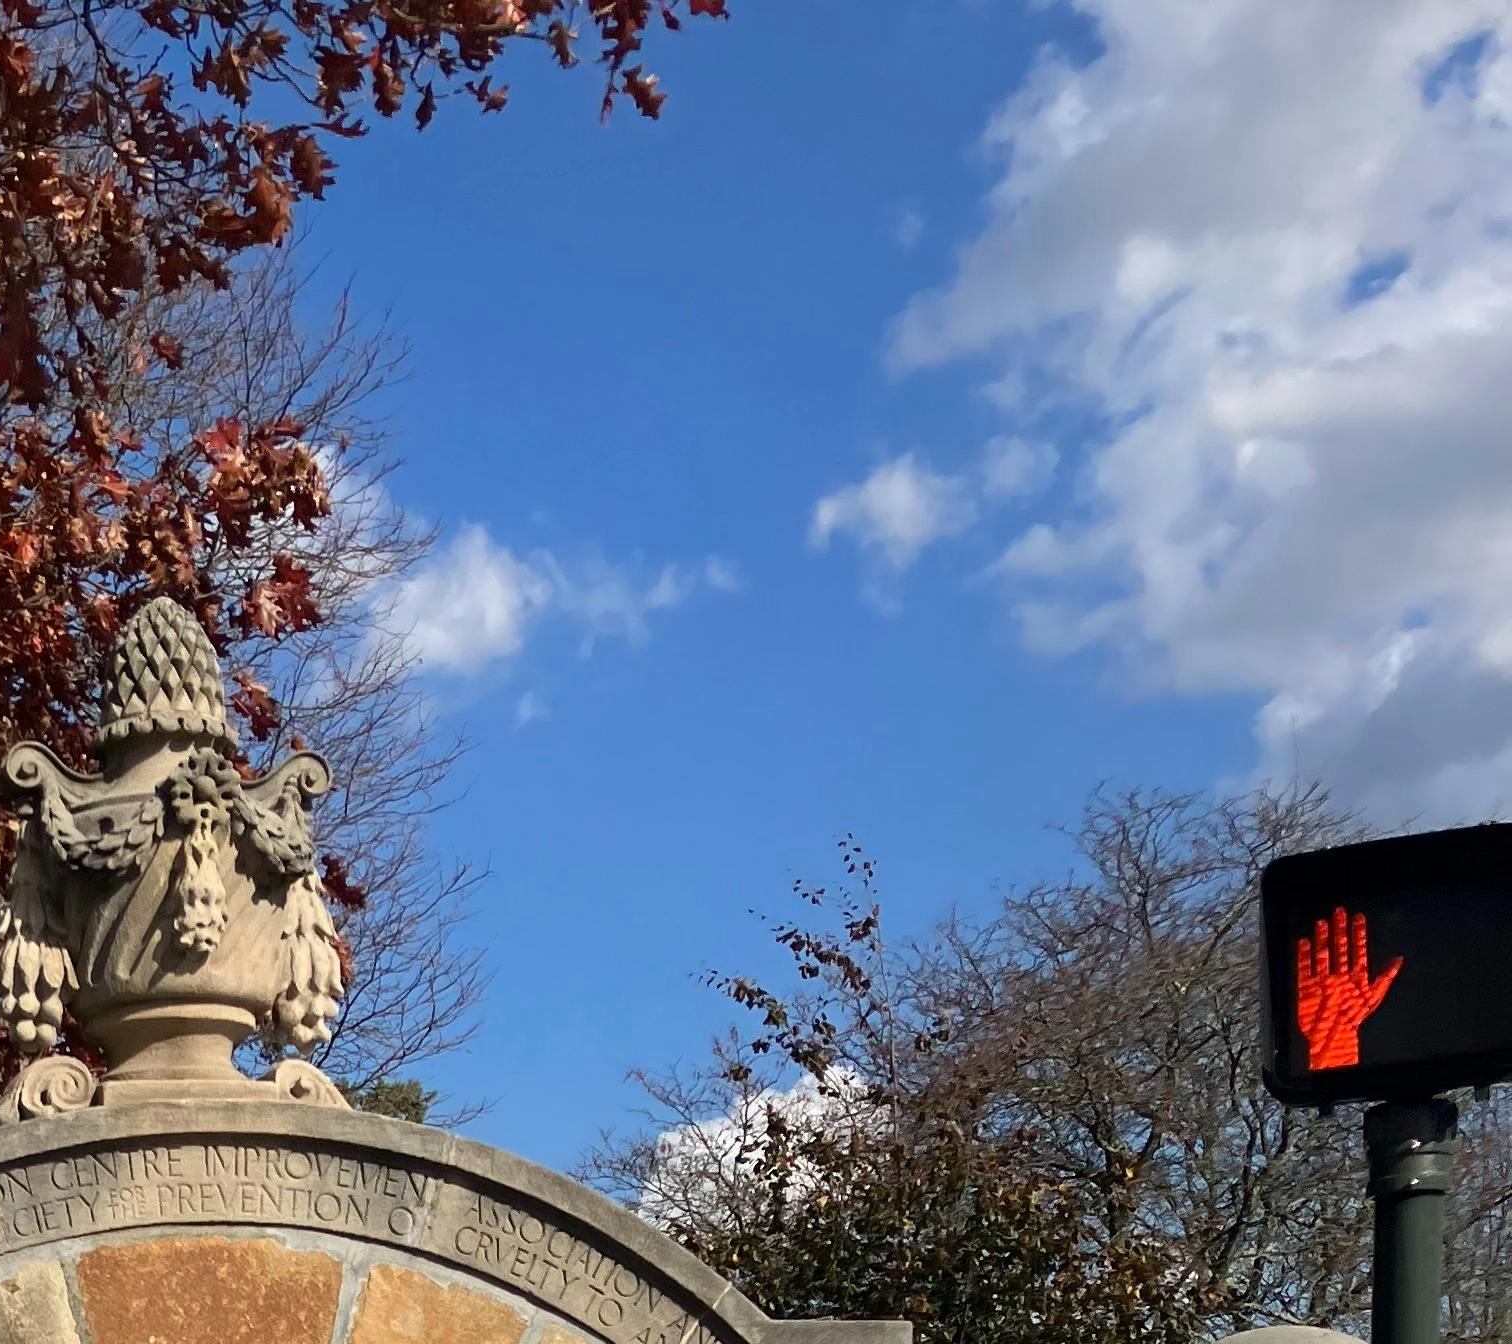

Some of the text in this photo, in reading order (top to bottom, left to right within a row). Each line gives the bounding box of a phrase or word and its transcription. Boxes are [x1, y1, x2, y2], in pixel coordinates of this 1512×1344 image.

[50, 1145, 183, 1191] CENTRE
[204, 1145, 430, 1203] IMPROVEMEN
[464, 1195, 665, 1313] ASSOCIATION
[157, 1183, 371, 1226] PREVENTION
[584, 1284, 624, 1327] TO
